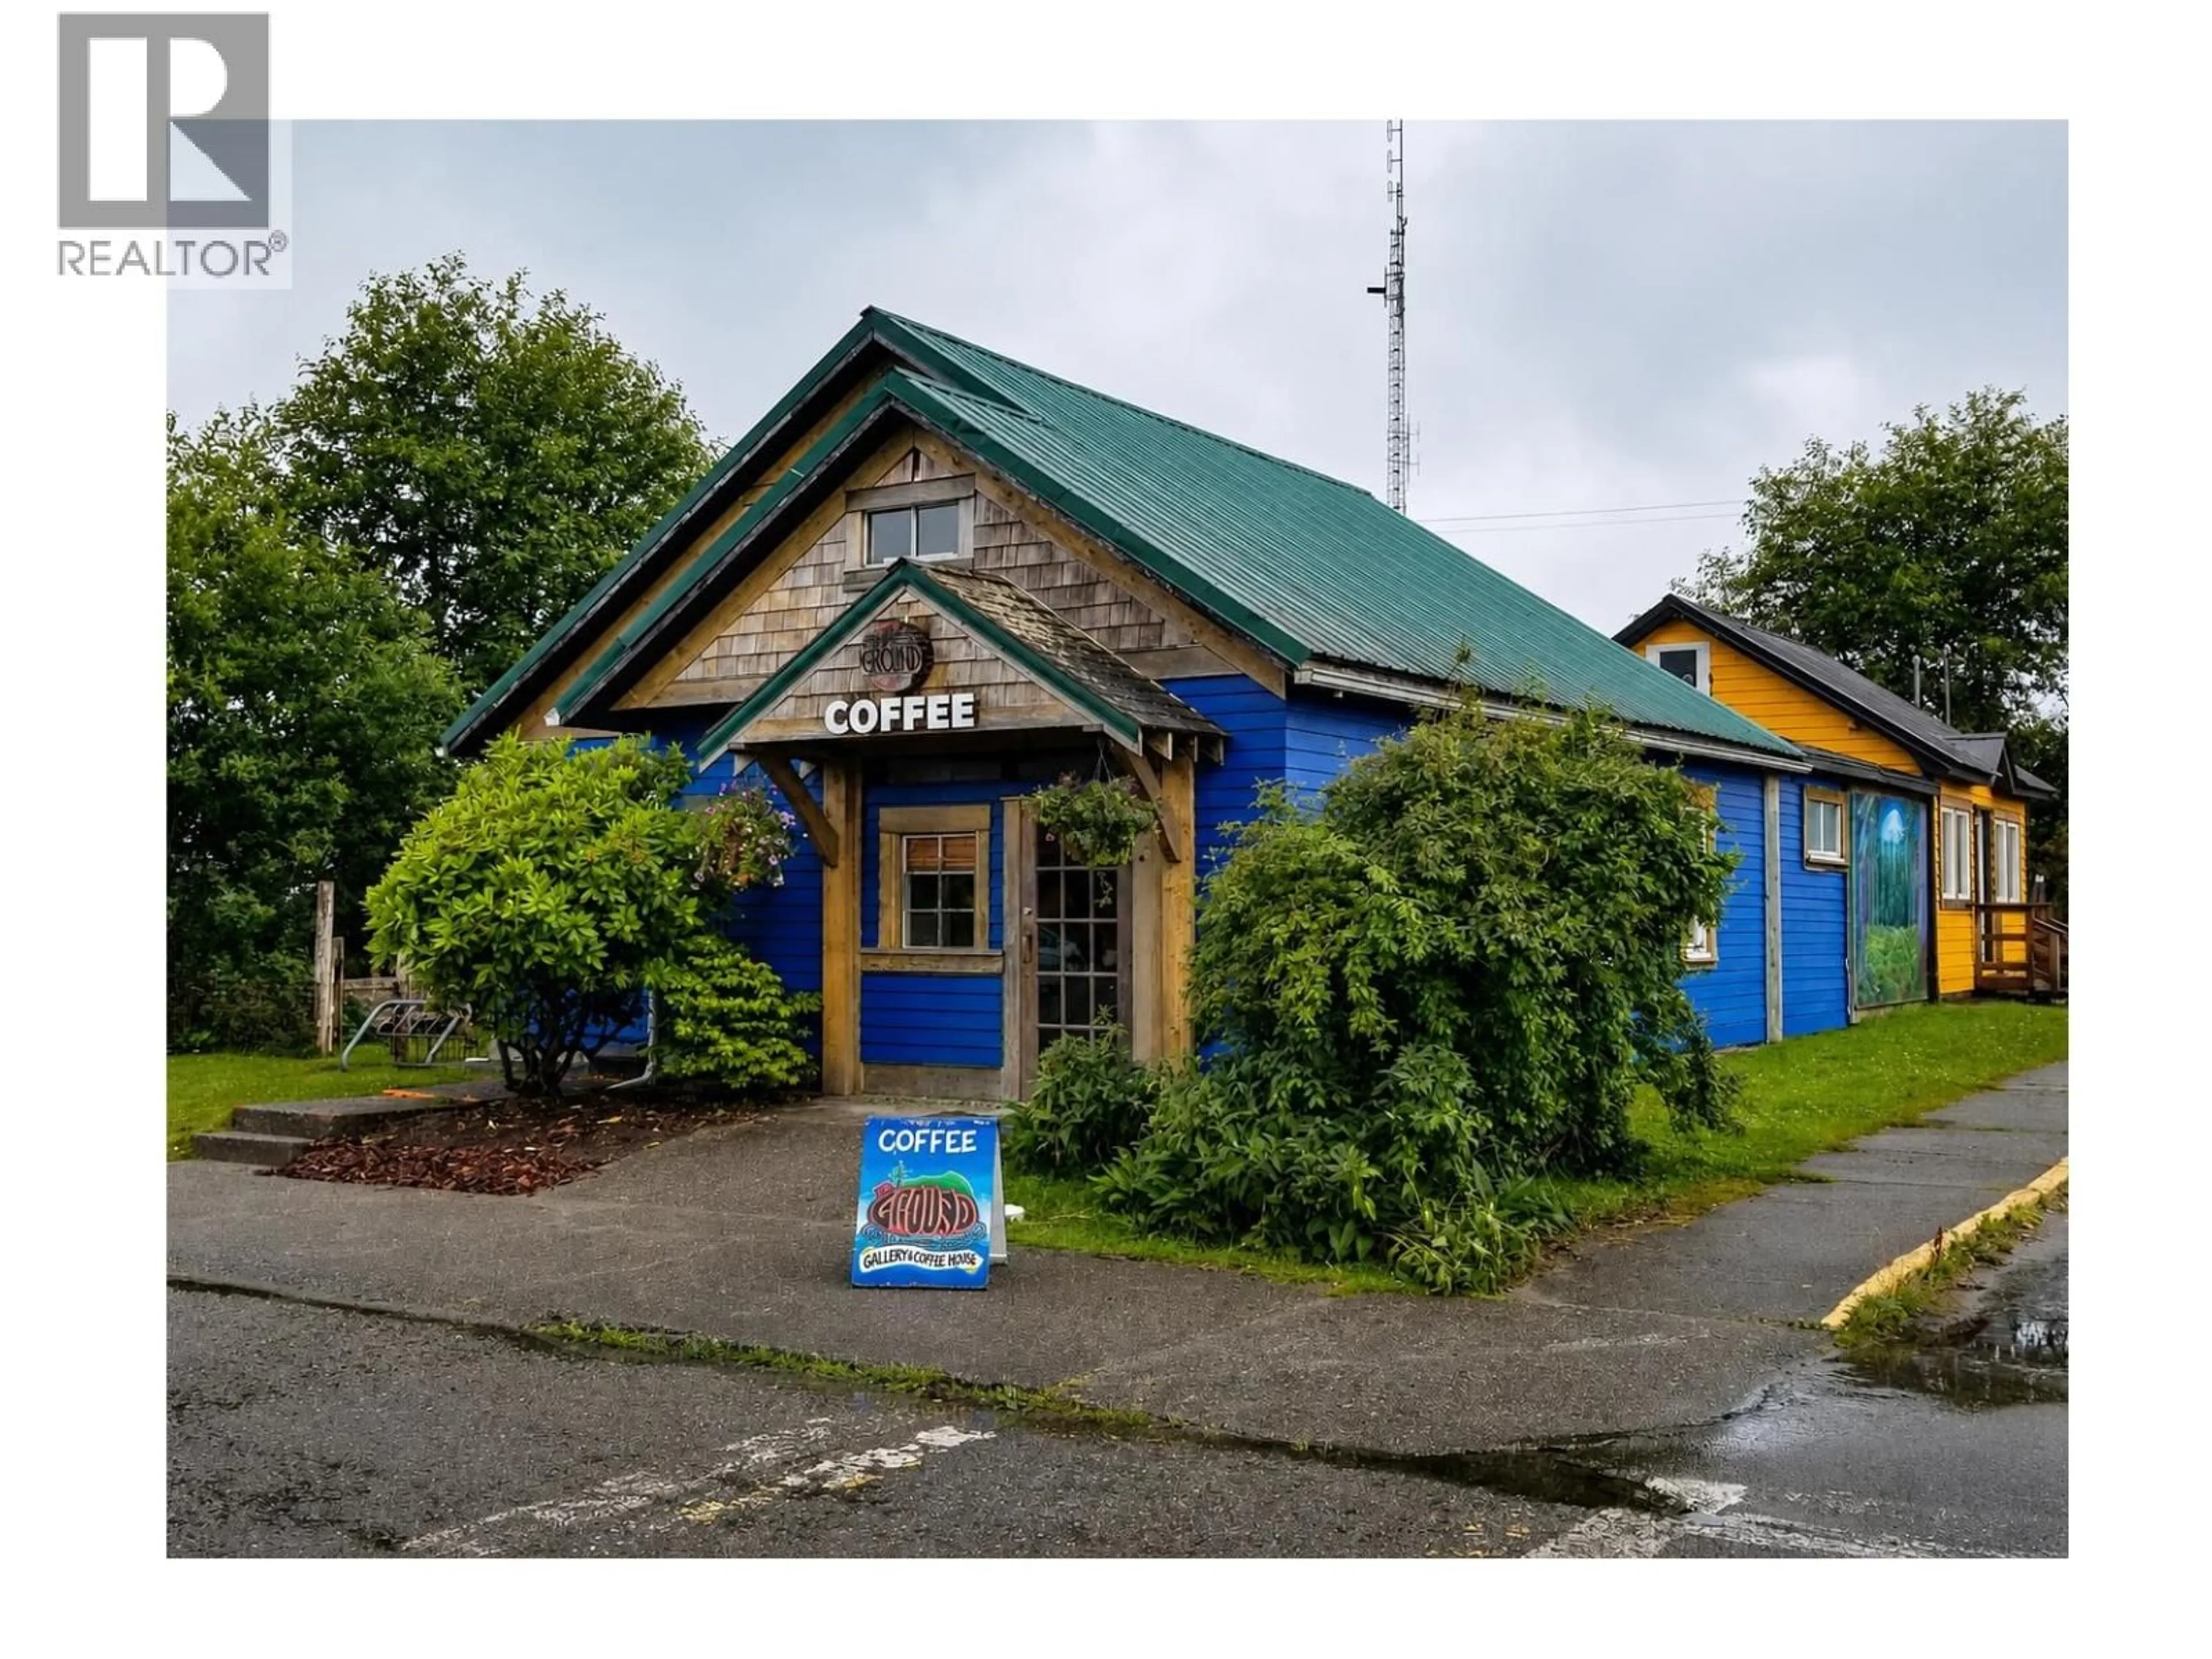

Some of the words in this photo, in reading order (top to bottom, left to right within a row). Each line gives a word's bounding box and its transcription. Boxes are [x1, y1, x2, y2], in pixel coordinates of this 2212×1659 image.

[824, 693, 975, 735] COFFEE
[878, 1128, 978, 1153] COFFEE
[948, 1252, 976, 1267] HOUSE
